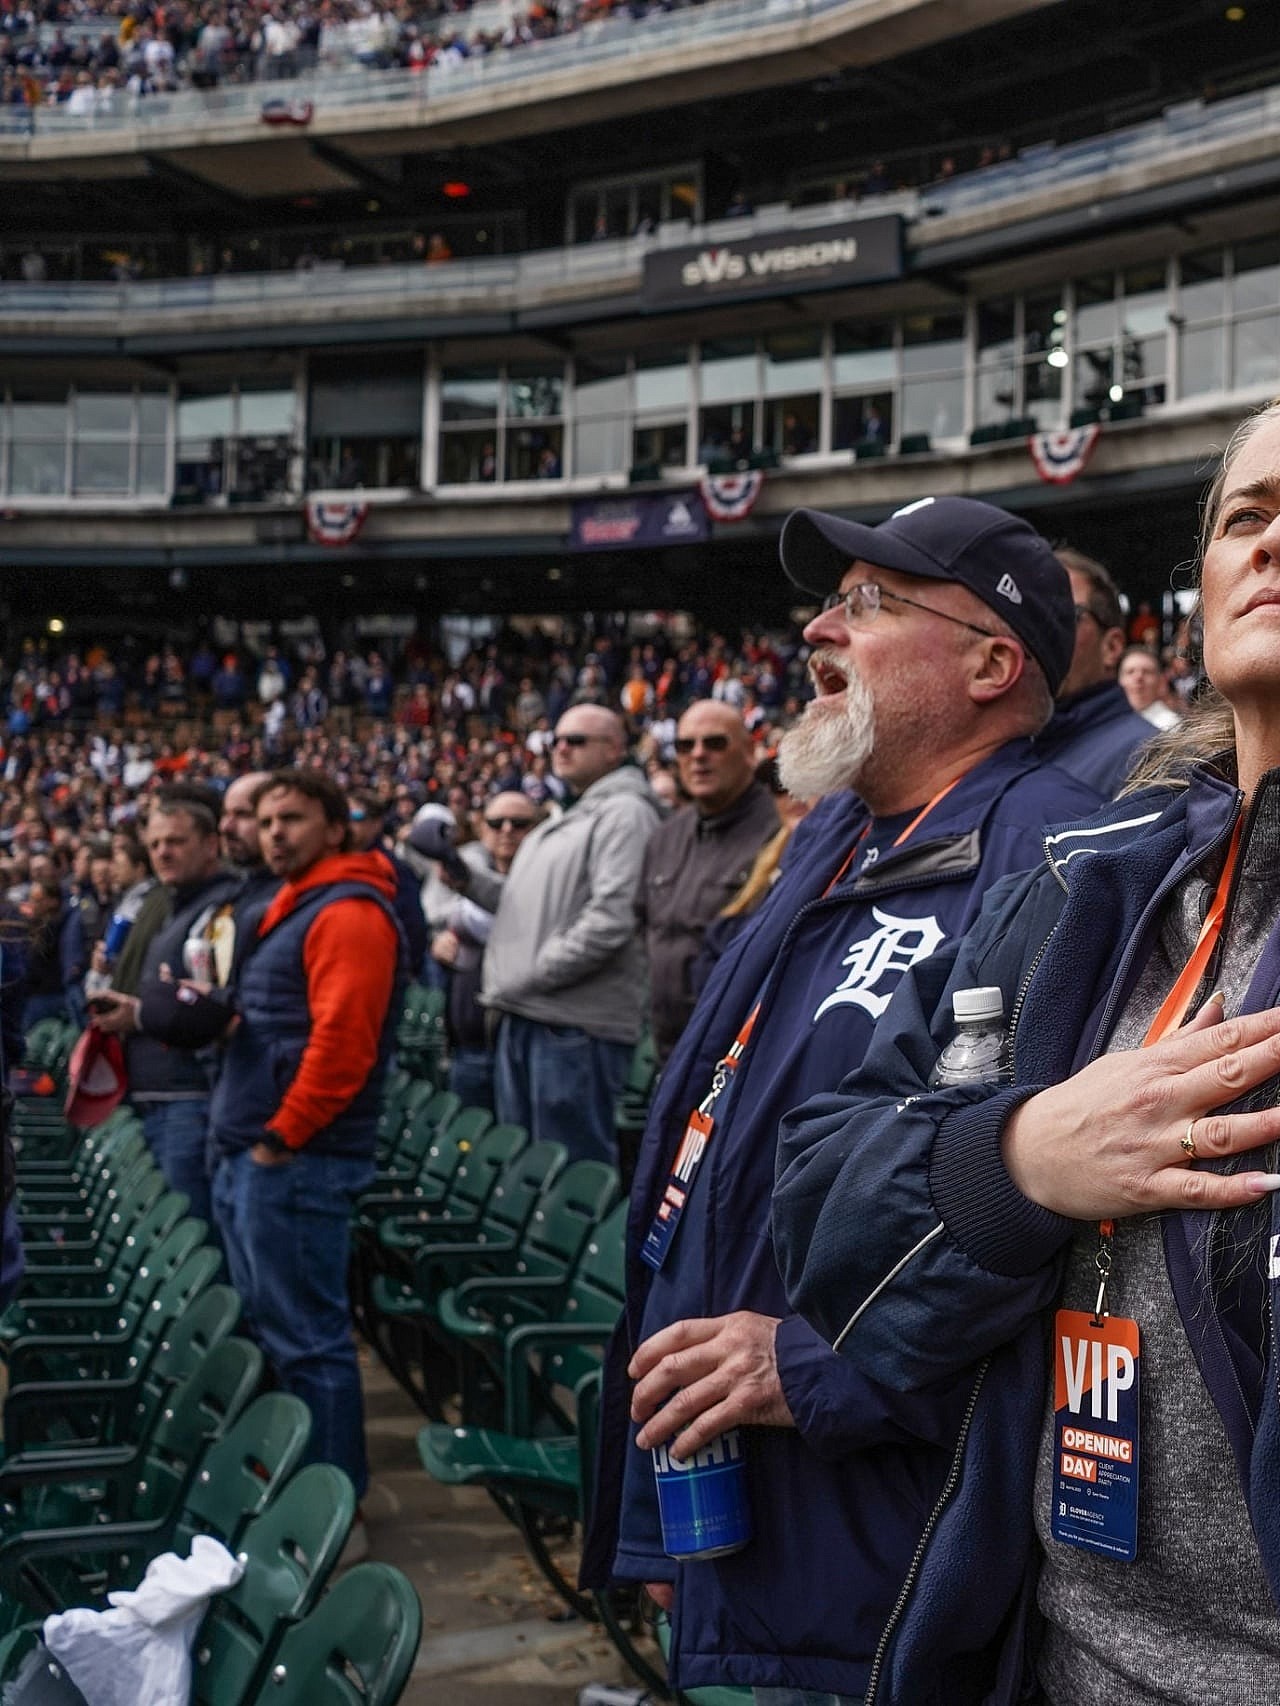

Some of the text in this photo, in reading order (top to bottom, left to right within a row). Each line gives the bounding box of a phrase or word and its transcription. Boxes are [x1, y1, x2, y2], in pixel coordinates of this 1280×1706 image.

[750, 237, 857, 275] VISION
[674, 1126, 707, 1183] VIP
[1062, 1336, 1134, 1422] VIP
[1064, 1430, 1130, 1460] OPENING
[1063, 1456, 1094, 1478] DAY
